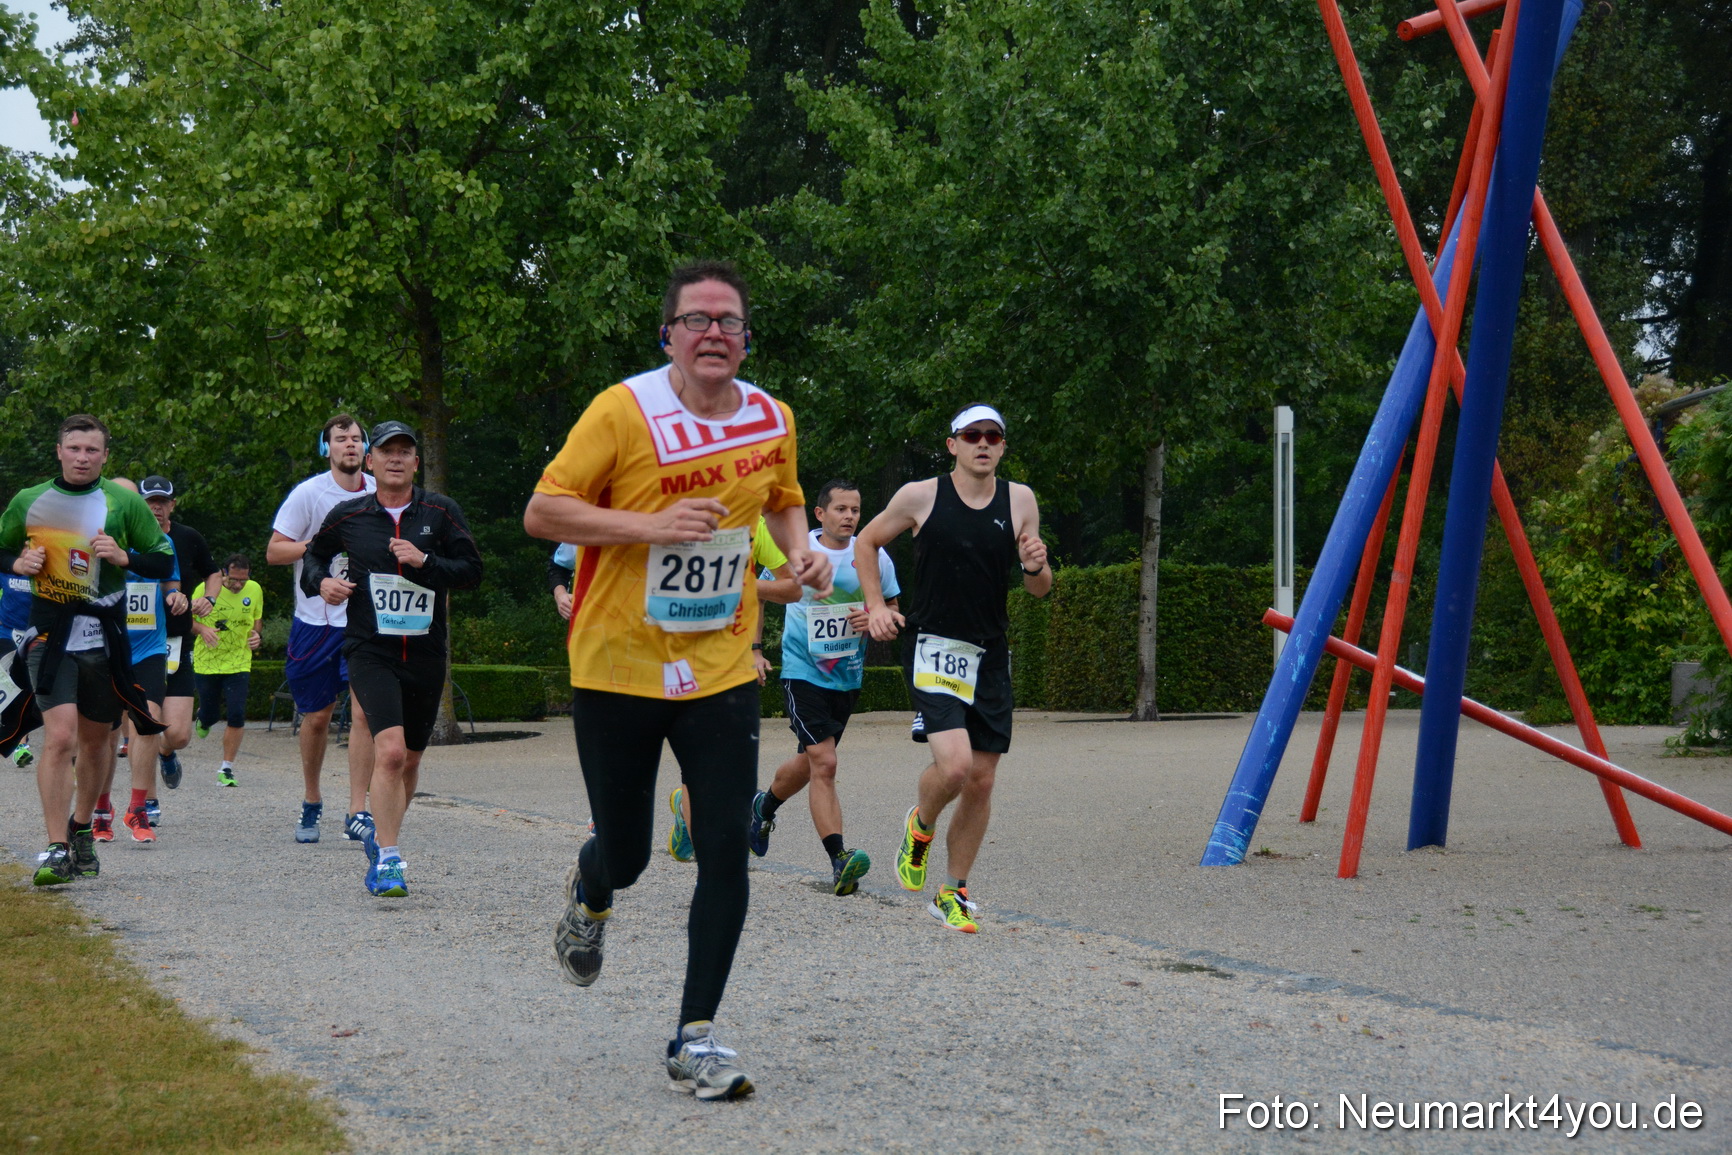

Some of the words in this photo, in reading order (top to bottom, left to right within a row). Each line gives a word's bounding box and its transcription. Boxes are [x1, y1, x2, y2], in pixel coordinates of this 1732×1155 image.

[660, 464, 727, 495] MAX
[734, 447, 786, 478] BÖGL
[659, 554, 741, 593] 2811
[129, 595, 149, 612] 50
[375, 588, 428, 613] 3074
[668, 602, 726, 619] Christoph
[814, 617, 857, 639] 267
[824, 642, 852, 652] Rüdiger
[930, 651, 969, 679] 188
[935, 676, 961, 693] Daniel
